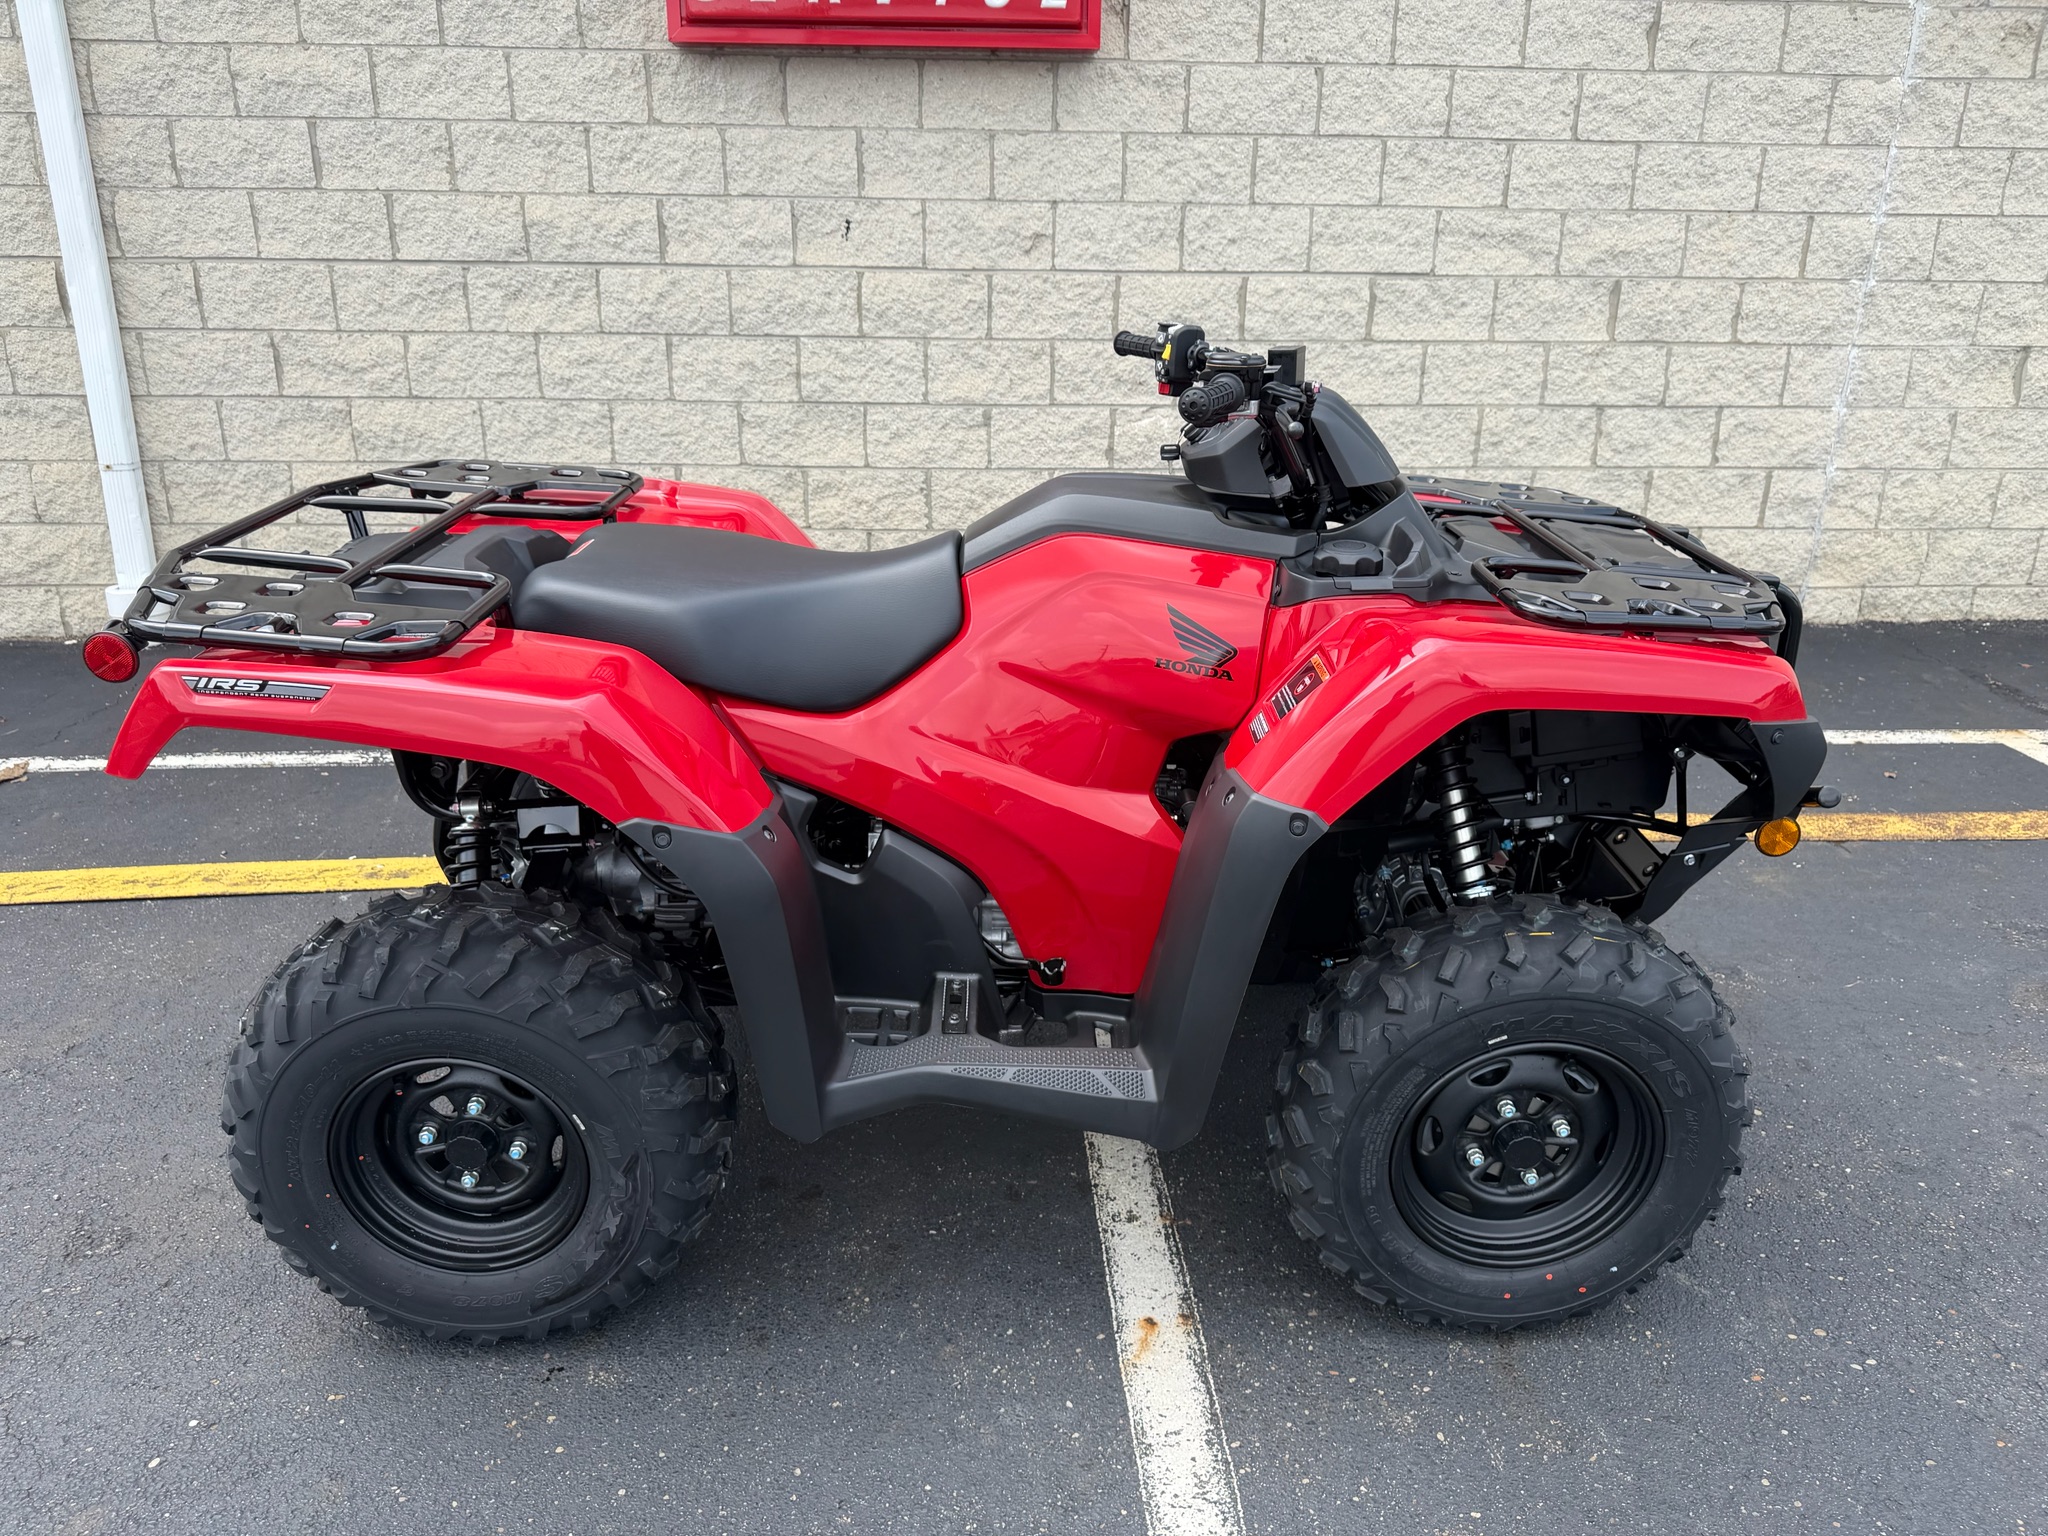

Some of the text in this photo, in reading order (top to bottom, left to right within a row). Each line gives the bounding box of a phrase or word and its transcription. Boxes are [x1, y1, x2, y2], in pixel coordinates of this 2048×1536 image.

[197, 677, 263, 691] IRS
[1153, 657, 1235, 682] HONDA
[1484, 1014, 1693, 1098] MAXXIS
[534, 1120, 627, 1299] MAXXIS
